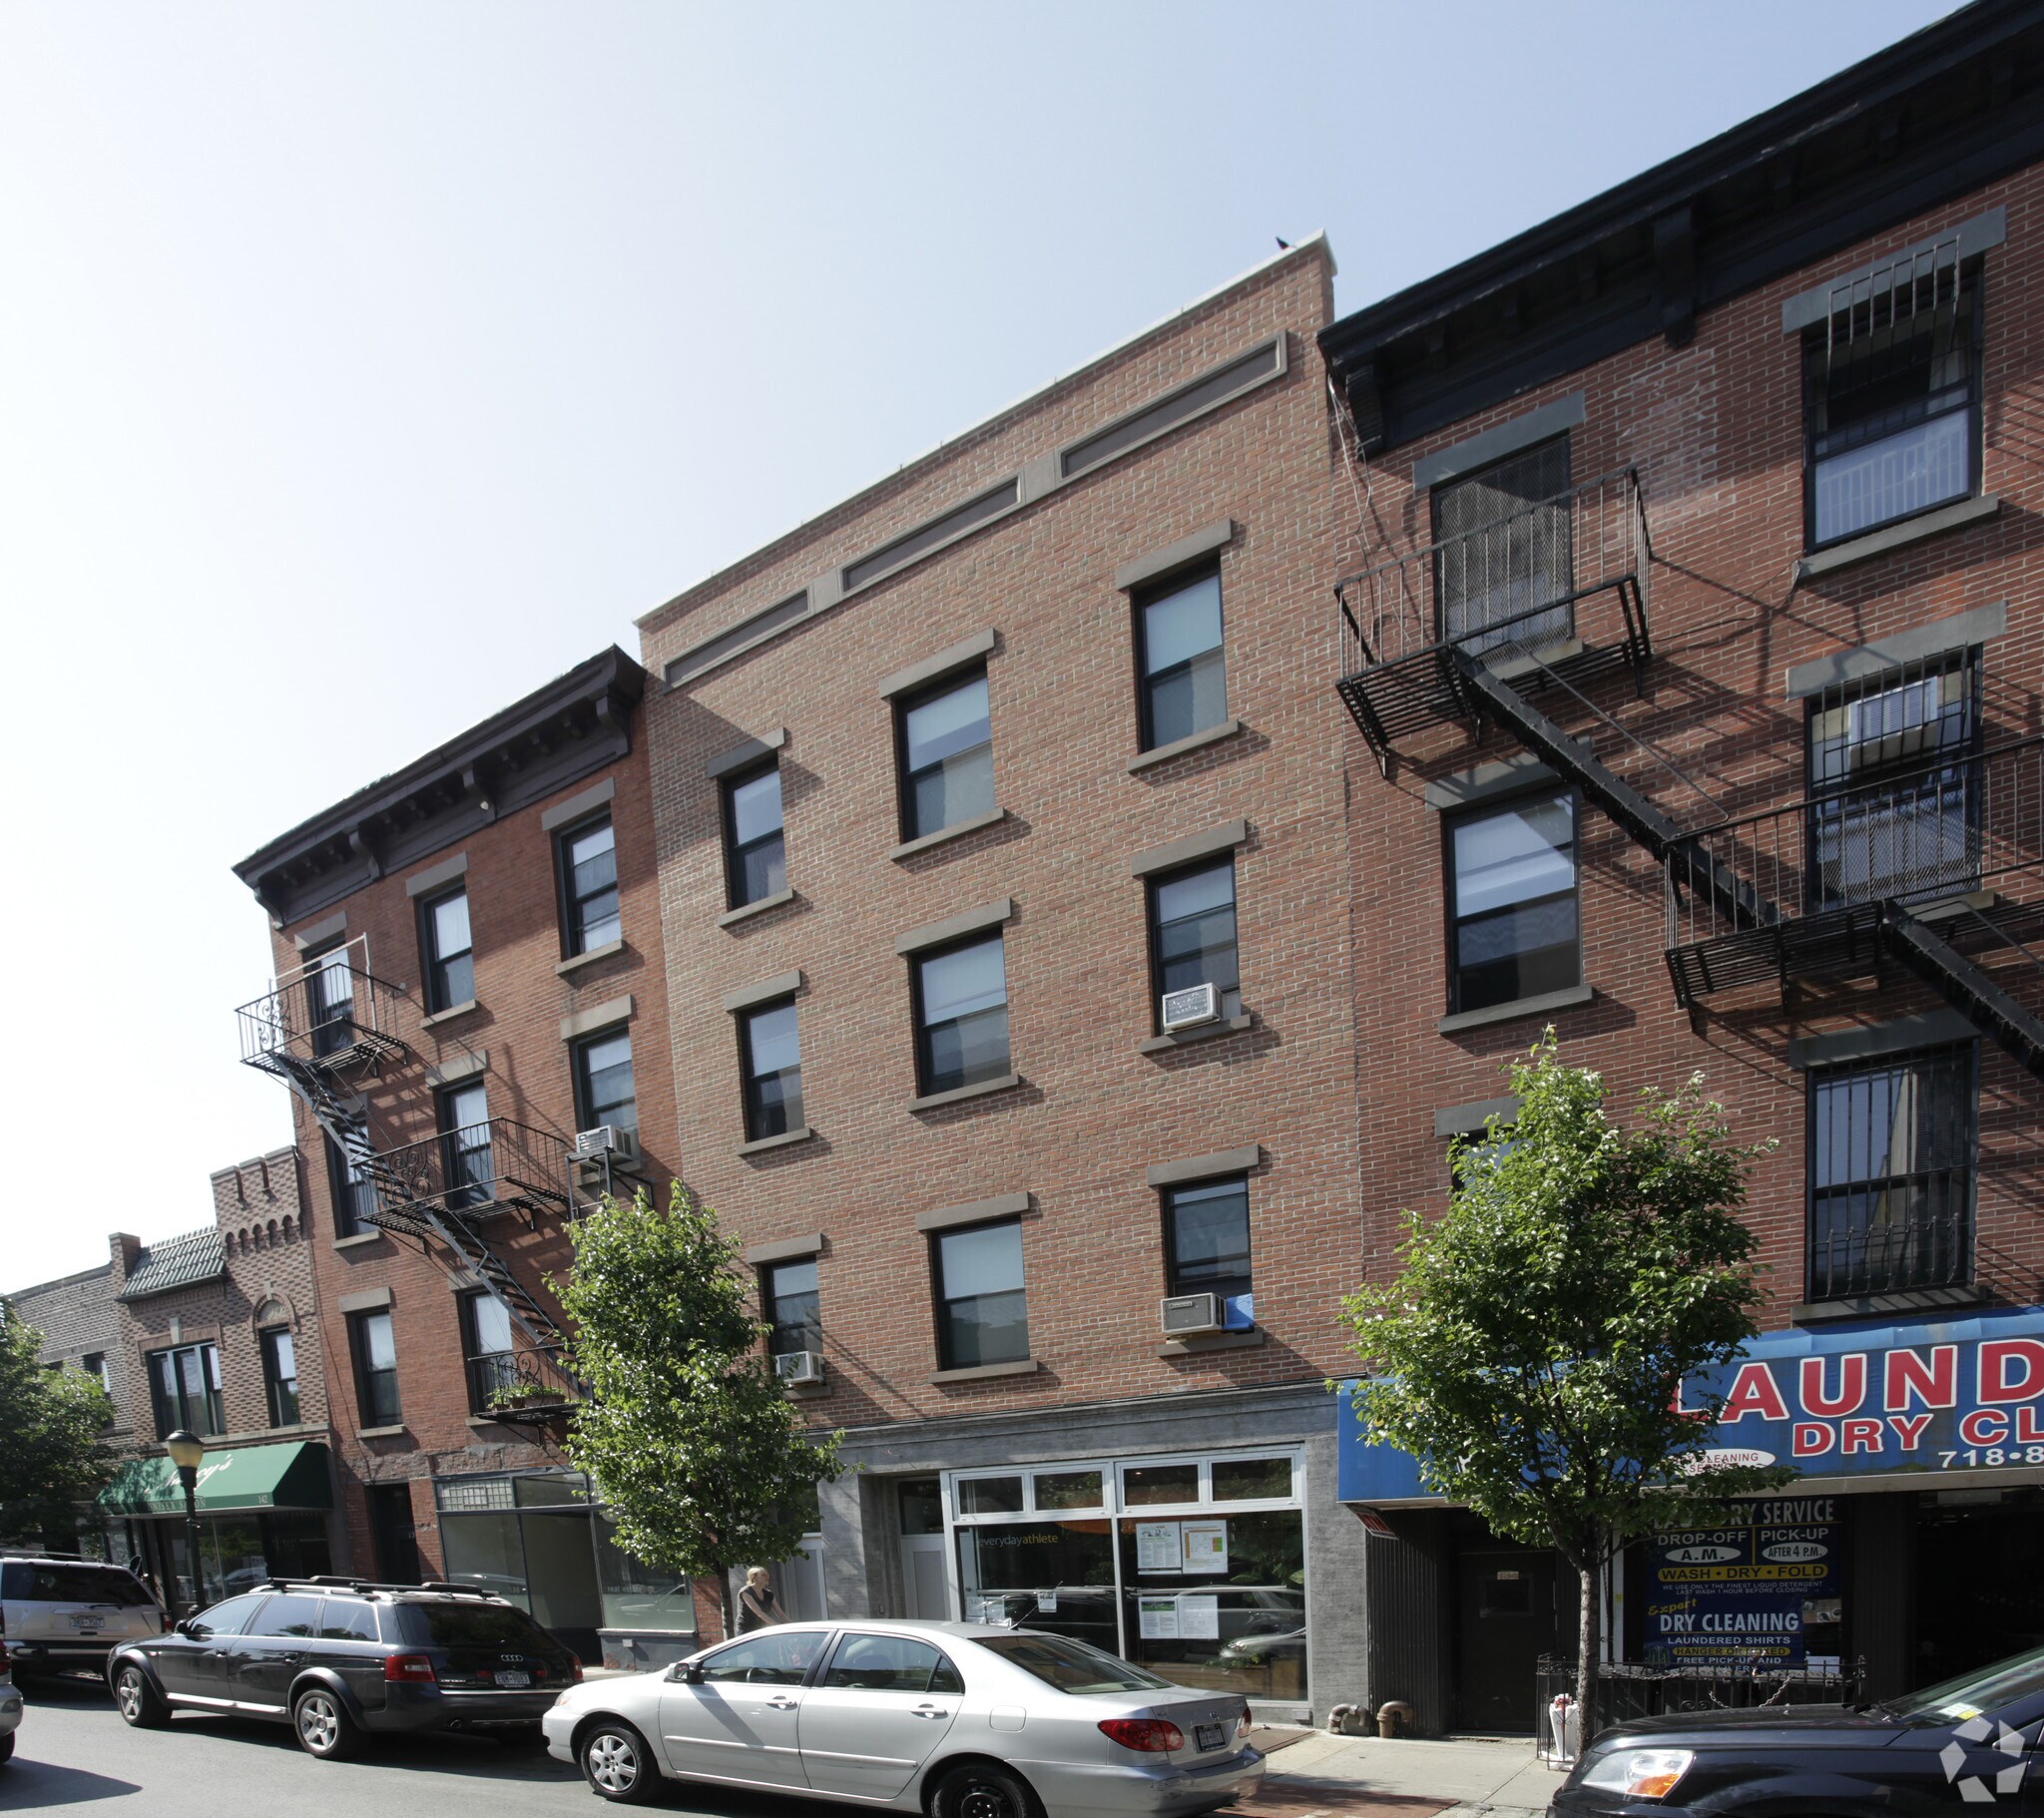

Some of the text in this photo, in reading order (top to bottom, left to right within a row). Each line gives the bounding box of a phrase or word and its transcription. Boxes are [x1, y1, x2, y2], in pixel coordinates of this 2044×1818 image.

[1792, 1406, 2044, 1458] DRY CL
[1700, 1453, 1760, 1465] CLEANING
[1763, 1500, 1834, 1525] SERVICE
[978, 1533, 1059, 1548] everydayathlete
[1658, 1531, 1748, 1546] DROP-OFF
[1761, 1528, 1829, 1542] PICK-UP
[1681, 1549, 1726, 1561] A.M.
[1768, 1546, 1822, 1558] AFTER 4 P.M.
[1662, 1567, 1824, 1580] WASH DRY FOLD
[1647, 1597, 1699, 1615] Expert
[1660, 1612, 1799, 1631] DRY CLEANING
